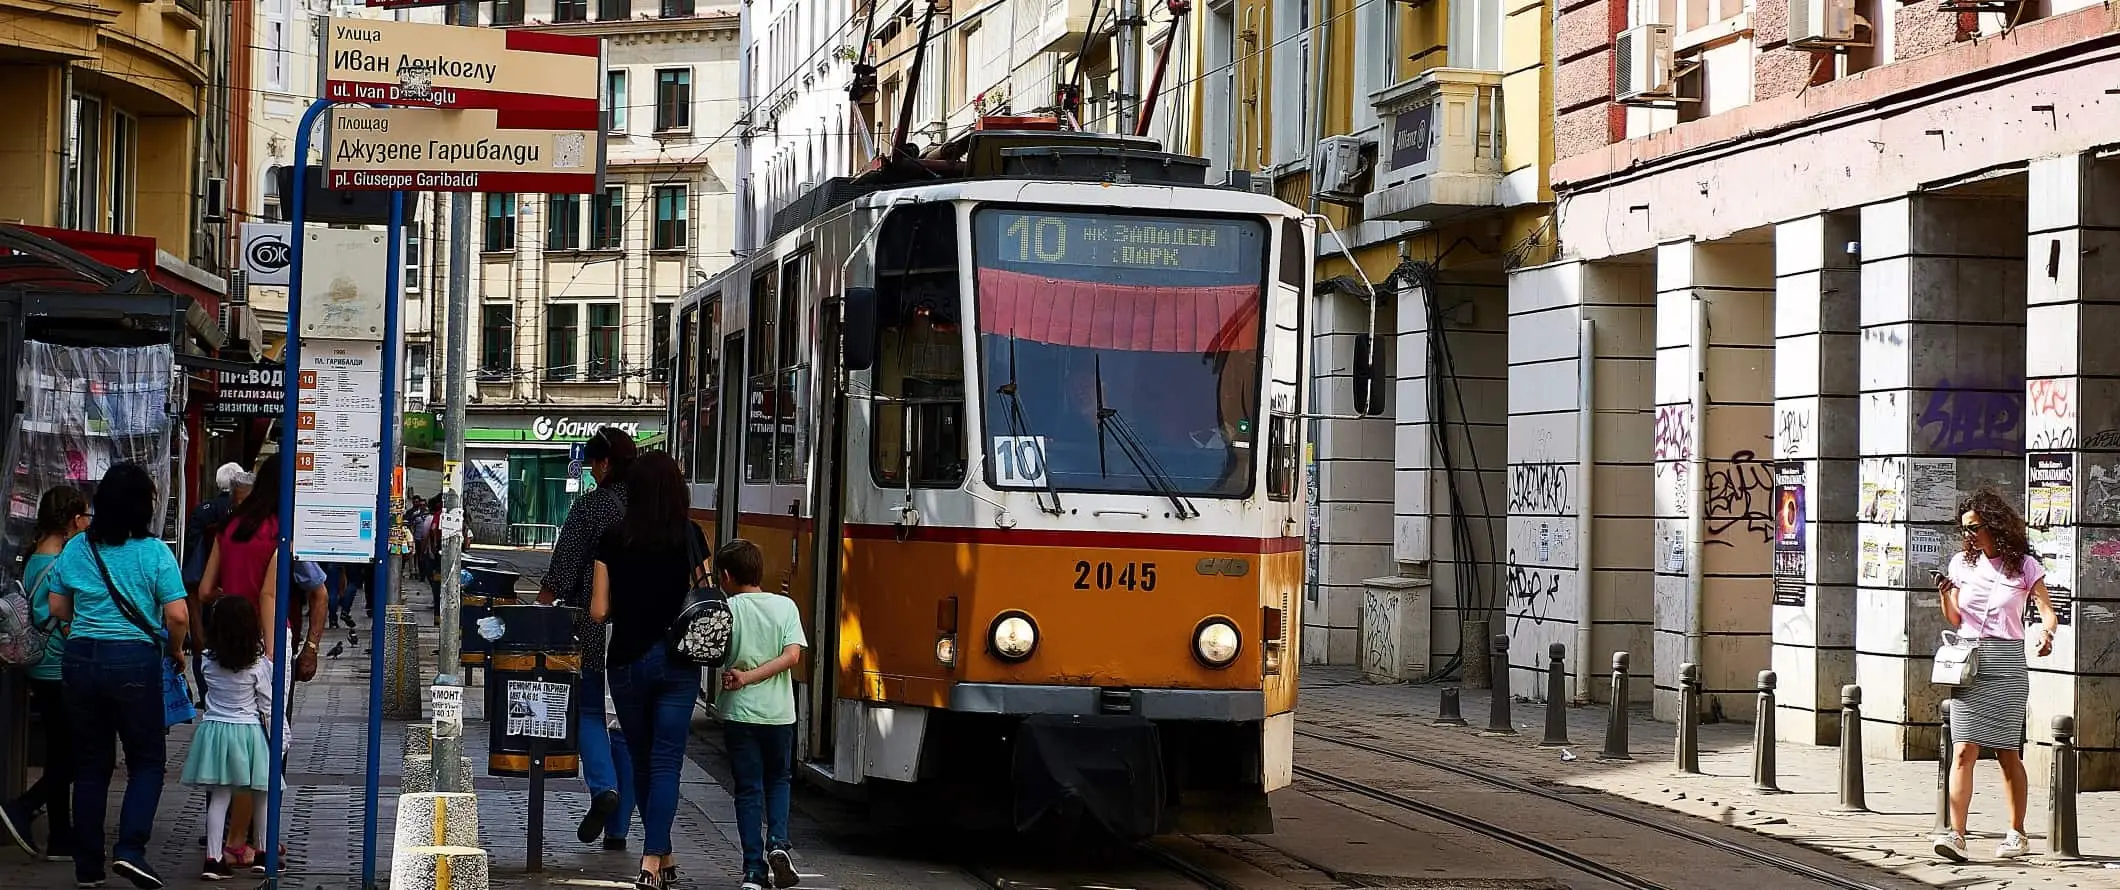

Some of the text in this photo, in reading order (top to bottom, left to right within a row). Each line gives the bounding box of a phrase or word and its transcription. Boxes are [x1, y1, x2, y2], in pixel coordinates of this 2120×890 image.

[336, 26, 381, 43] Улица
[334, 50, 389, 72] Иван
[355, 84, 384, 99] Ivan
[338, 117, 388, 132] Площад
[1396, 128, 1417, 151] Allianz
[336, 139, 539, 165] Джузепе Гарибалди
[353, 173, 412, 189] Giuseppe
[416, 173, 478, 187] Garibaldi
[1007, 216, 1067, 262] 10
[1113, 224, 1216, 246] ЗАПАДЕН
[303, 375, 314, 384] 10
[219, 403, 258, 412] ВИЗИТКИ
[302, 416, 312, 425] 12
[301, 456, 311, 466] 18
[997, 440, 1043, 481] 10
[1074, 560, 1156, 591] 2045
